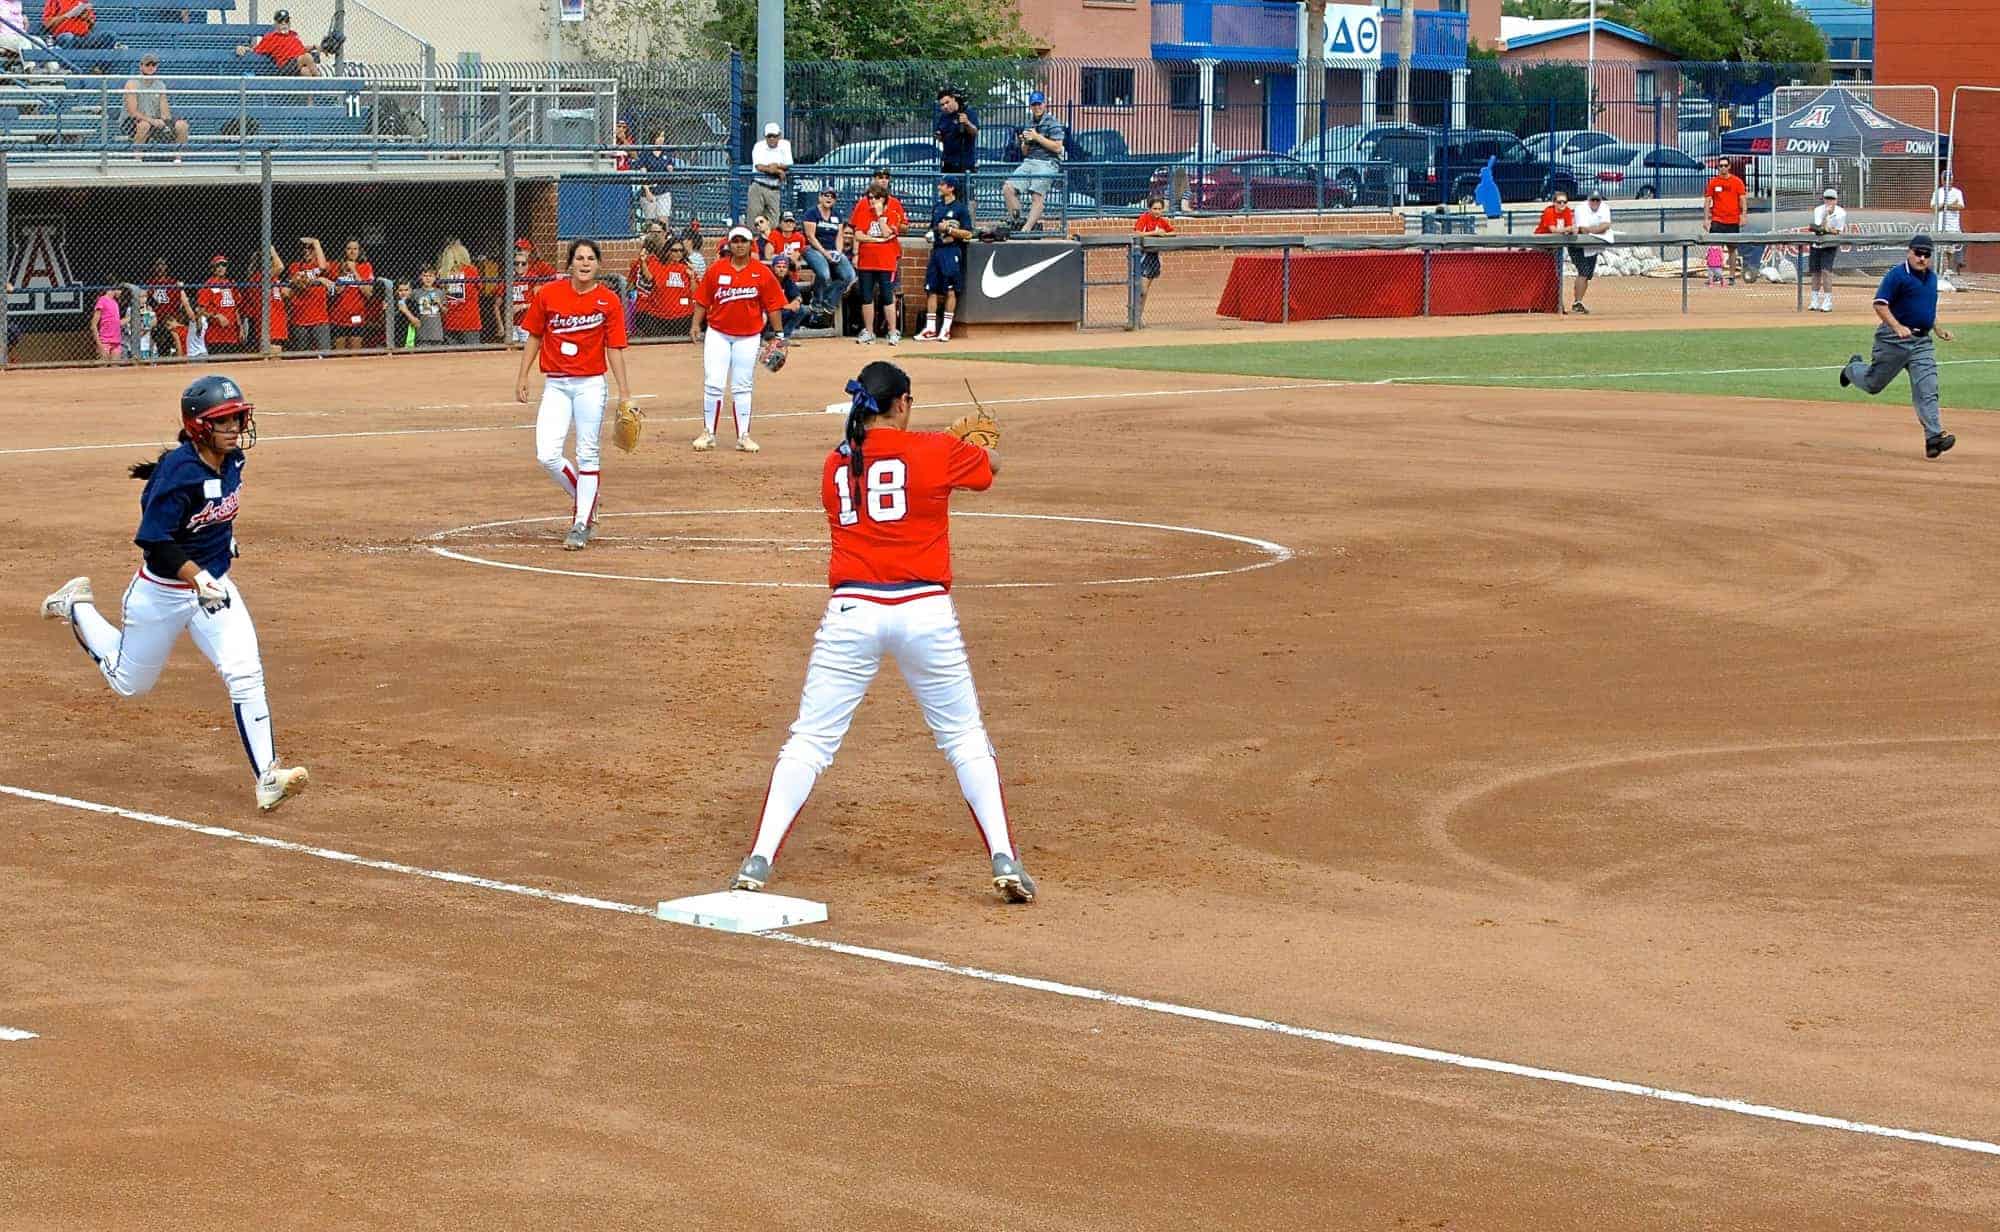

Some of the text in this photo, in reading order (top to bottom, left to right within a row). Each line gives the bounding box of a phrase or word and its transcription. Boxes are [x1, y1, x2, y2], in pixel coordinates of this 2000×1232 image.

[346, 95, 360, 117] 11
[548, 312, 605, 330] Arizona
[834, 459, 908, 525] 18
